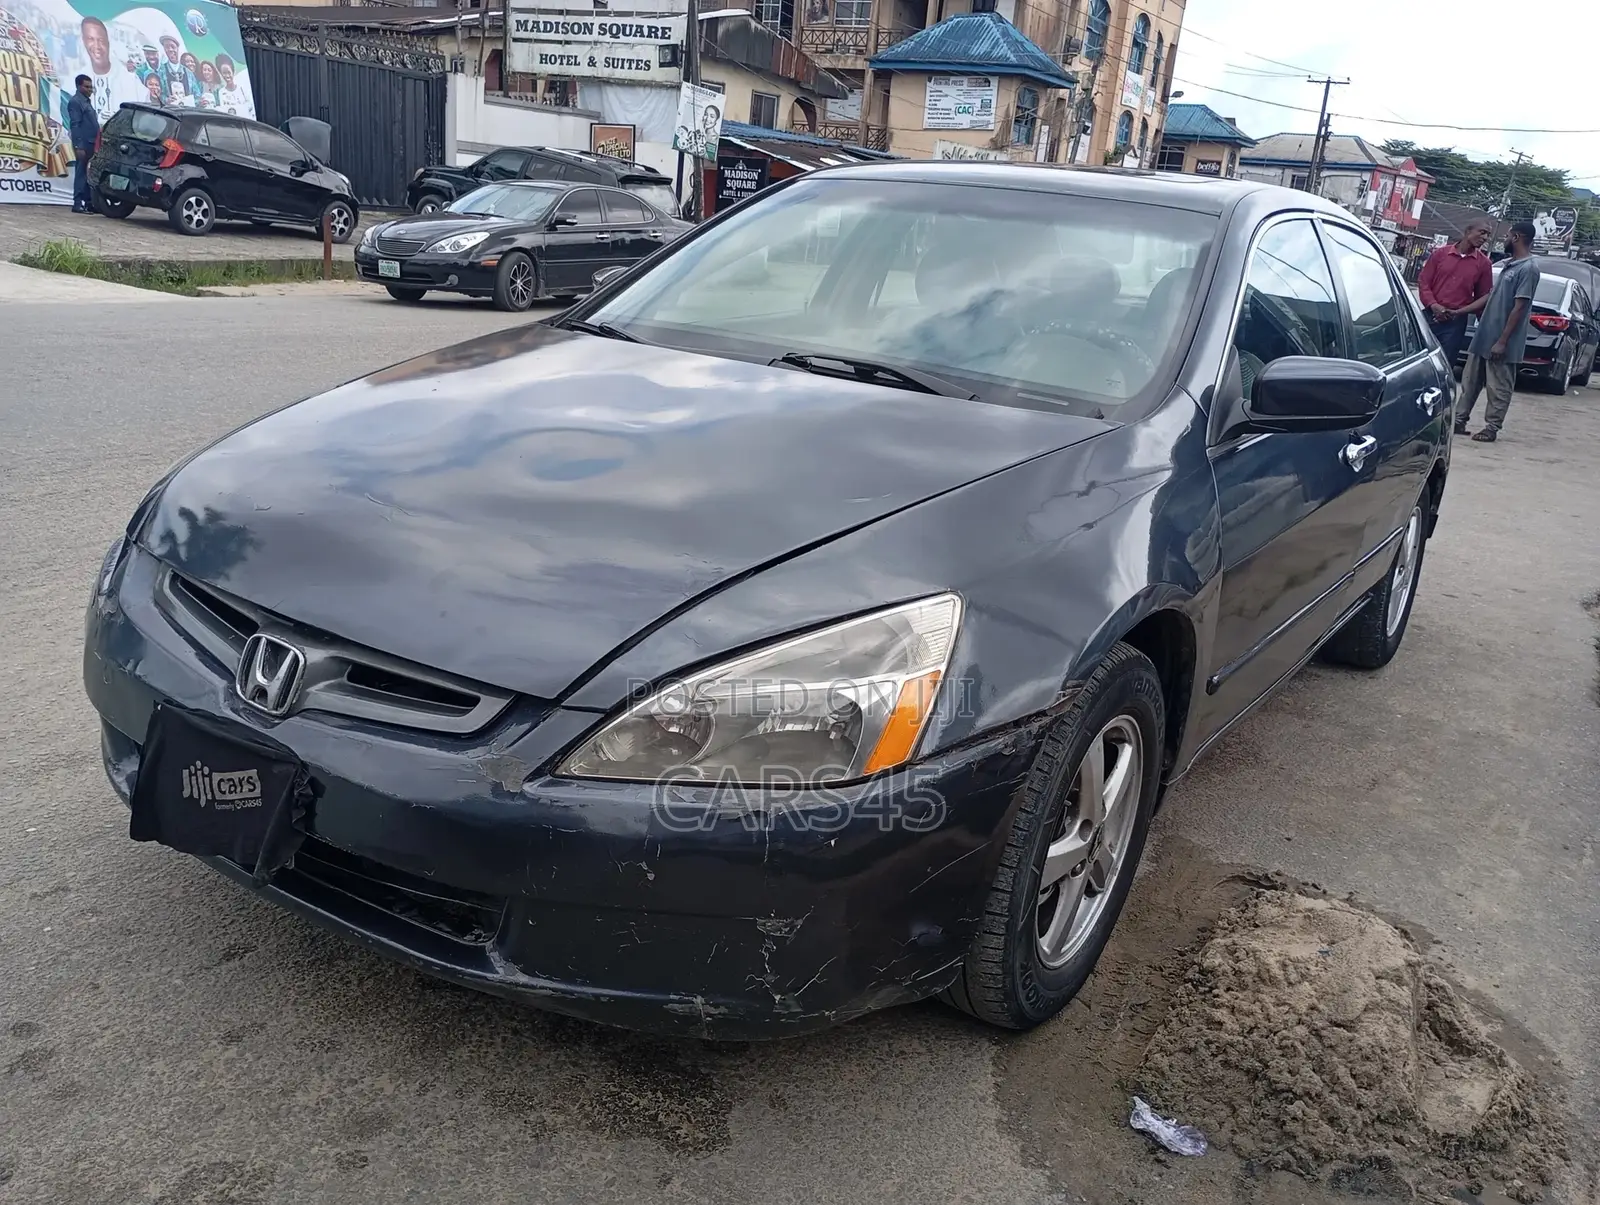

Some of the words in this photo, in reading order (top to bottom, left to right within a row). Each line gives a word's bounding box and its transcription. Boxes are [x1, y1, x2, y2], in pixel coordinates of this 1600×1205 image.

[515, 19, 594, 35] MADISON
[598, 22, 672, 40] SQUARE
[539, 53, 581, 66] HOTEL
[587, 56, 597, 68] &
[604, 56, 652, 71] SUITES
[724, 169, 758, 181] MADISON
[726, 179, 757, 190] SQUARE
[217, 776, 256, 795] cars
